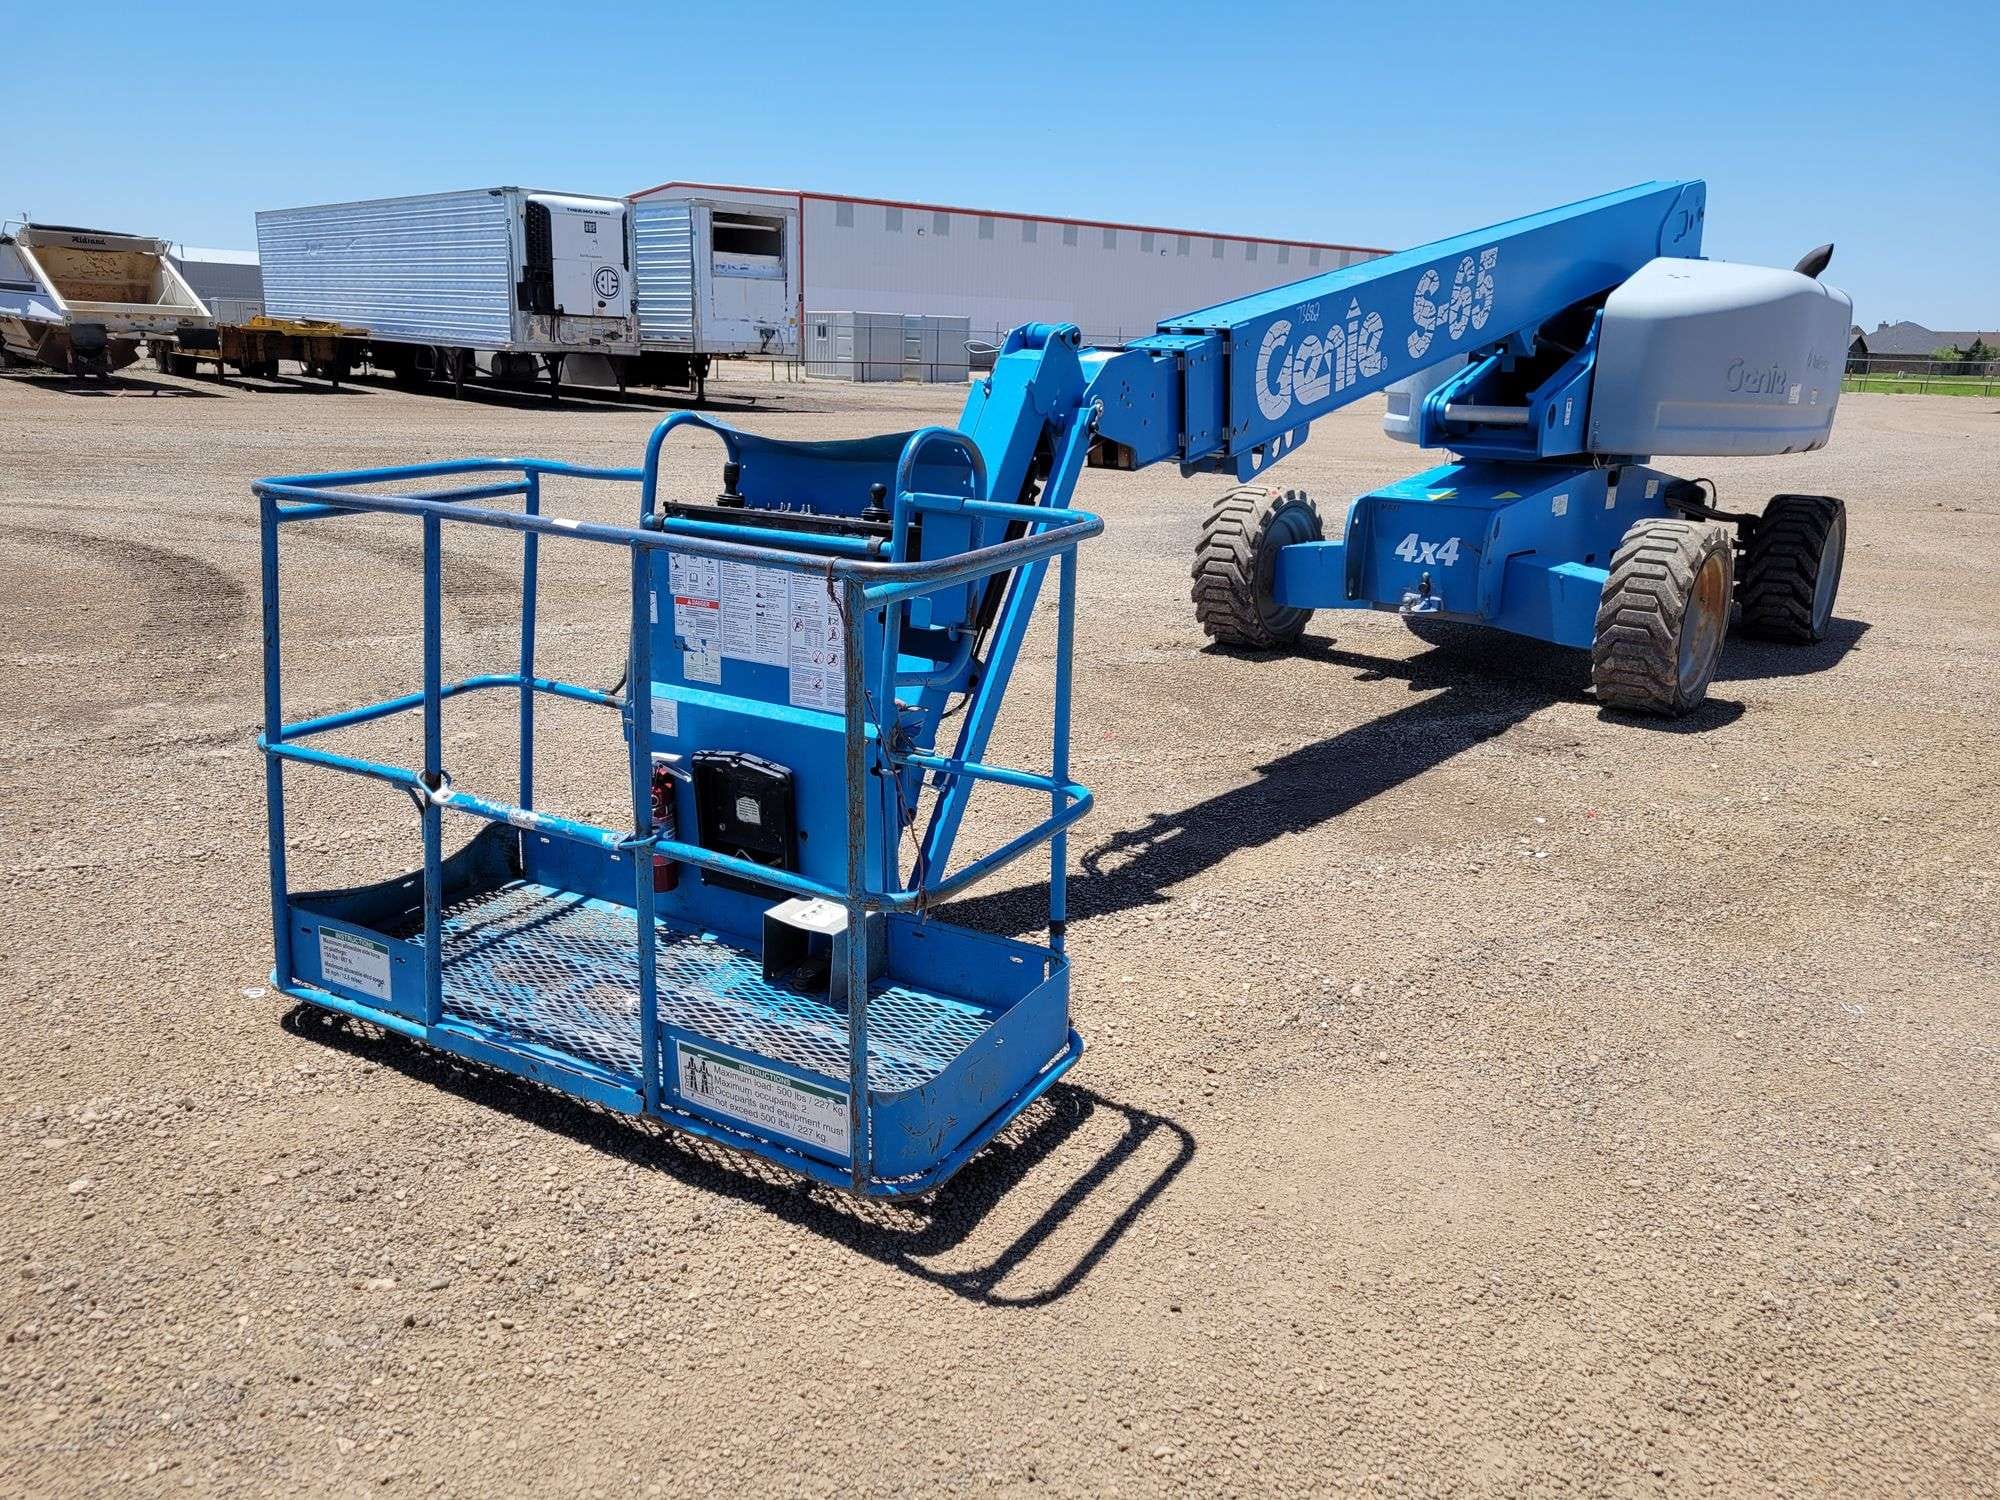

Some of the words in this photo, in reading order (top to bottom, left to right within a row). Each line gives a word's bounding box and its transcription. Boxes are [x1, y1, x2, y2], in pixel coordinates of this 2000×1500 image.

[1407, 247, 1499, 359] S-65
[1394, 533, 1461, 567] 4x4
[714, 1065, 752, 1084] Maximum
[754, 1079, 774, 1091] load:
[777, 1086, 792, 1098] 500
[794, 1091, 807, 1103] lbs
[815, 1099, 830, 1110] 227
[715, 1075, 752, 1096] Maximum
[738, 1064, 791, 1086] INSTRUCTIONS
[715, 1086, 757, 1107] Occupants
[760, 1102, 774, 1113] and
[777, 1108, 821, 1128] equipment
[823, 1124, 844, 1136] must
[716, 1098, 727, 1108] not
[730, 1103, 758, 1118] exceed
[761, 1112, 776, 1125] 500
[778, 1117, 790, 1129] lbs
[798, 1125, 813, 1136] 227
